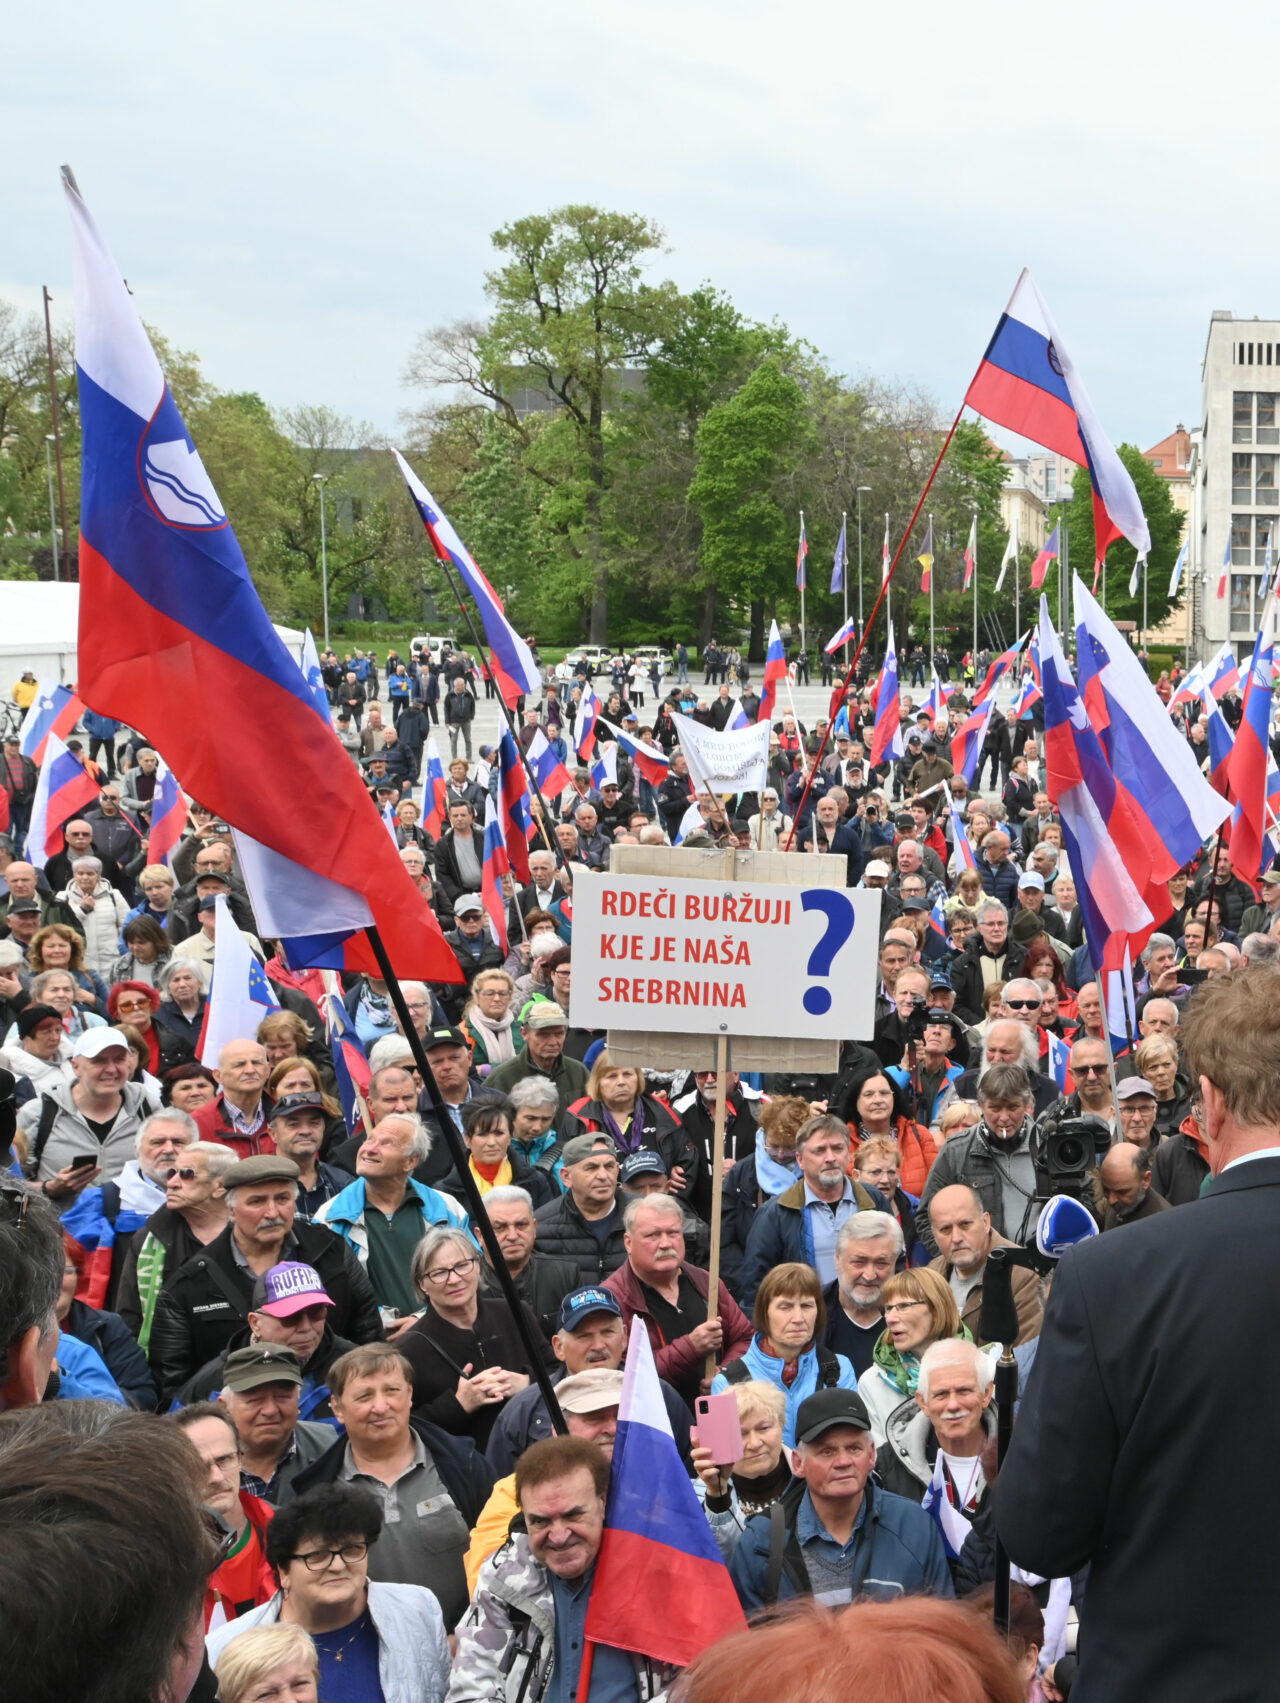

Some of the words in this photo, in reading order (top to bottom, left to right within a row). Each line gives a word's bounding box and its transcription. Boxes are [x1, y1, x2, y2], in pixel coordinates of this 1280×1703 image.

[602, 888, 676, 919] RDEČI
[684, 893, 792, 925] BURŽUJI
[600, 934, 644, 960] KJE
[650, 936, 676, 962] JE
[684, 935, 752, 966] NAŠA
[800, 888, 856, 1016] ?
[598, 977, 747, 1008] SREBRNINA
